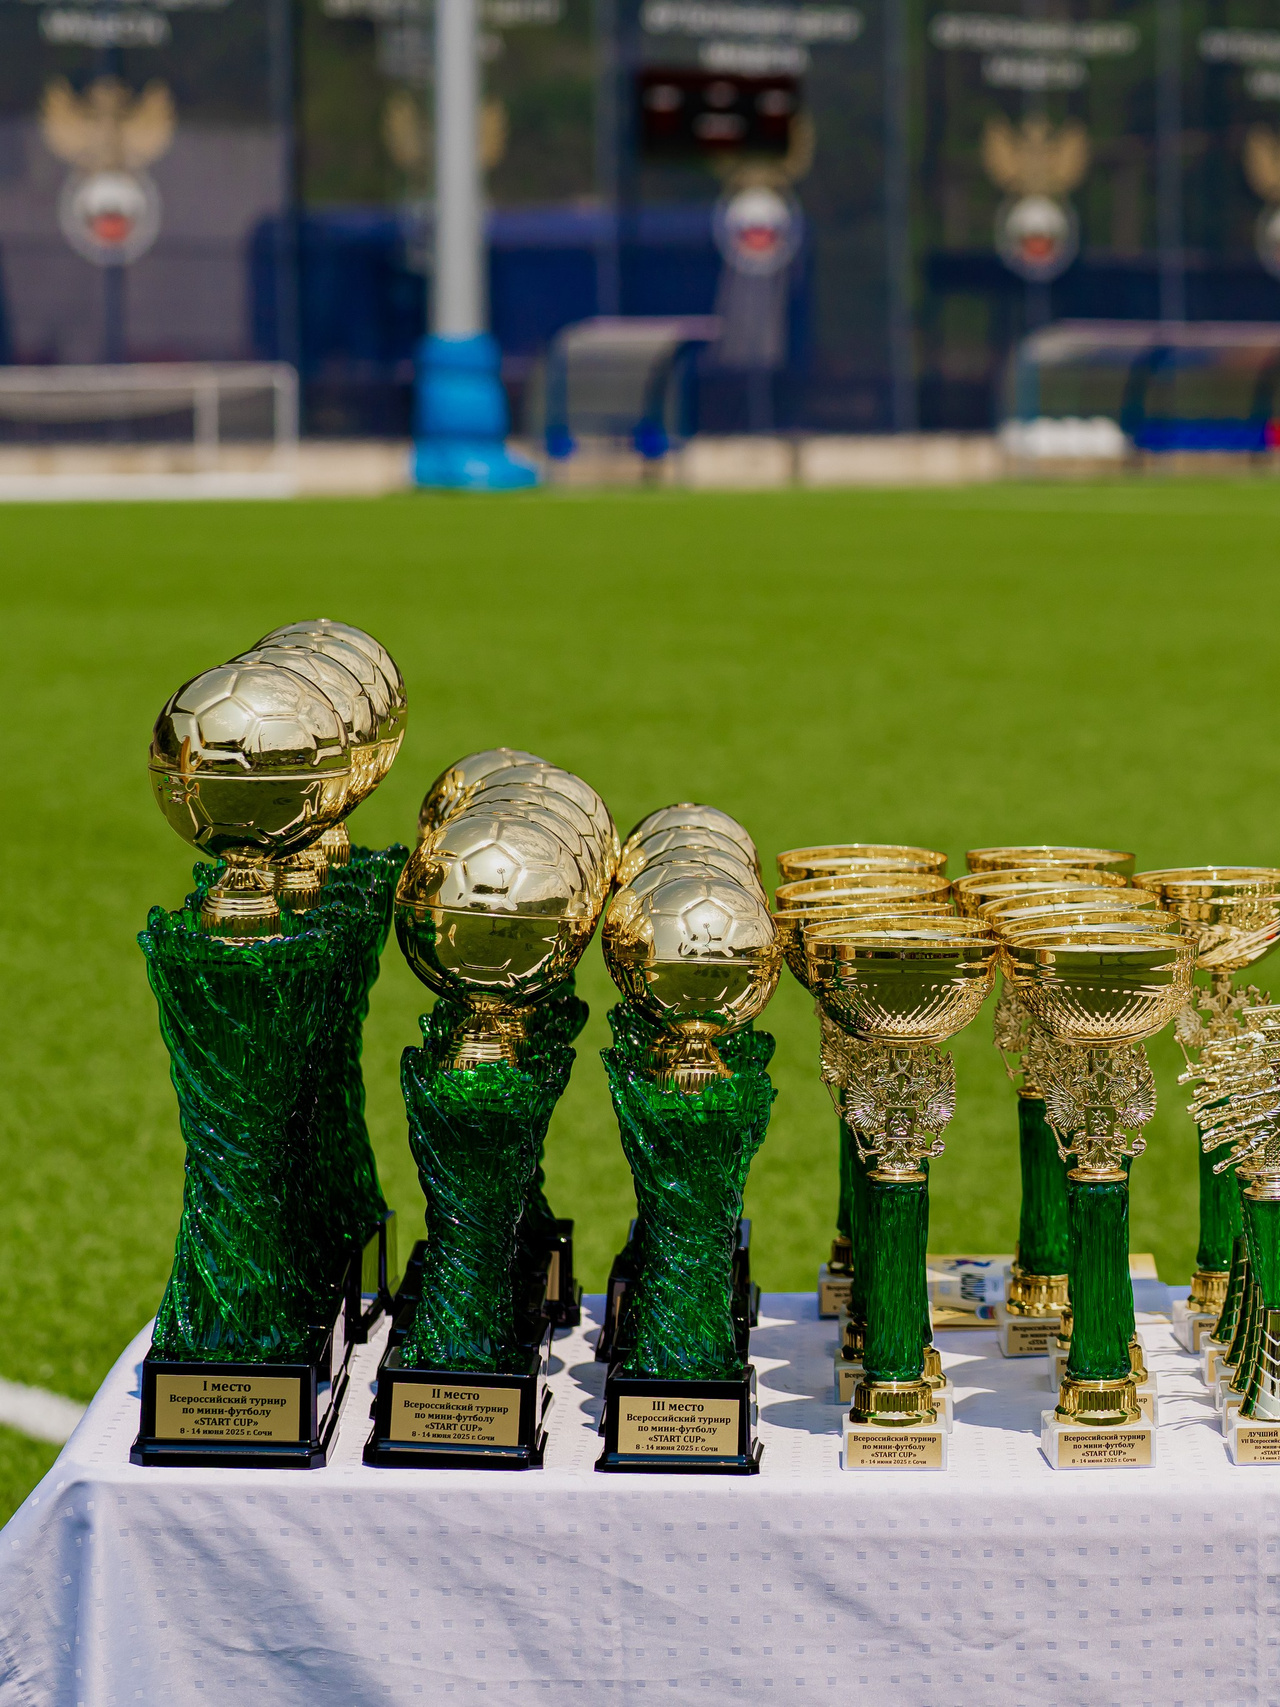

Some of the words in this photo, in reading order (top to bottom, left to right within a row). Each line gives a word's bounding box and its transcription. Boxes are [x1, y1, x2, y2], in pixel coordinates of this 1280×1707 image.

[203, 1381, 207, 1391] I
[211, 1383, 251, 1392] место
[432, 1389, 440, 1398] II
[444, 1391, 479, 1400] место
[170, 1394, 247, 1404] Всероссийский
[250, 1398, 286, 1406] турнир
[404, 1401, 473, 1411] Всероссийский
[476, 1406, 508, 1414] турнир
[652, 1401, 665, 1410] III
[669, 1403, 704, 1411] место
[197, 1407, 271, 1416] мини-футболу
[194, 1418, 231, 1426] «START
[428, 1414, 494, 1423] мини-футболу
[627, 1414, 695, 1423] Всероссийский
[698, 1417, 731, 1425] турнир
[651, 1426, 717, 1435] мини-футболу
[1064, 1434, 1118, 1442] Всероссийский
